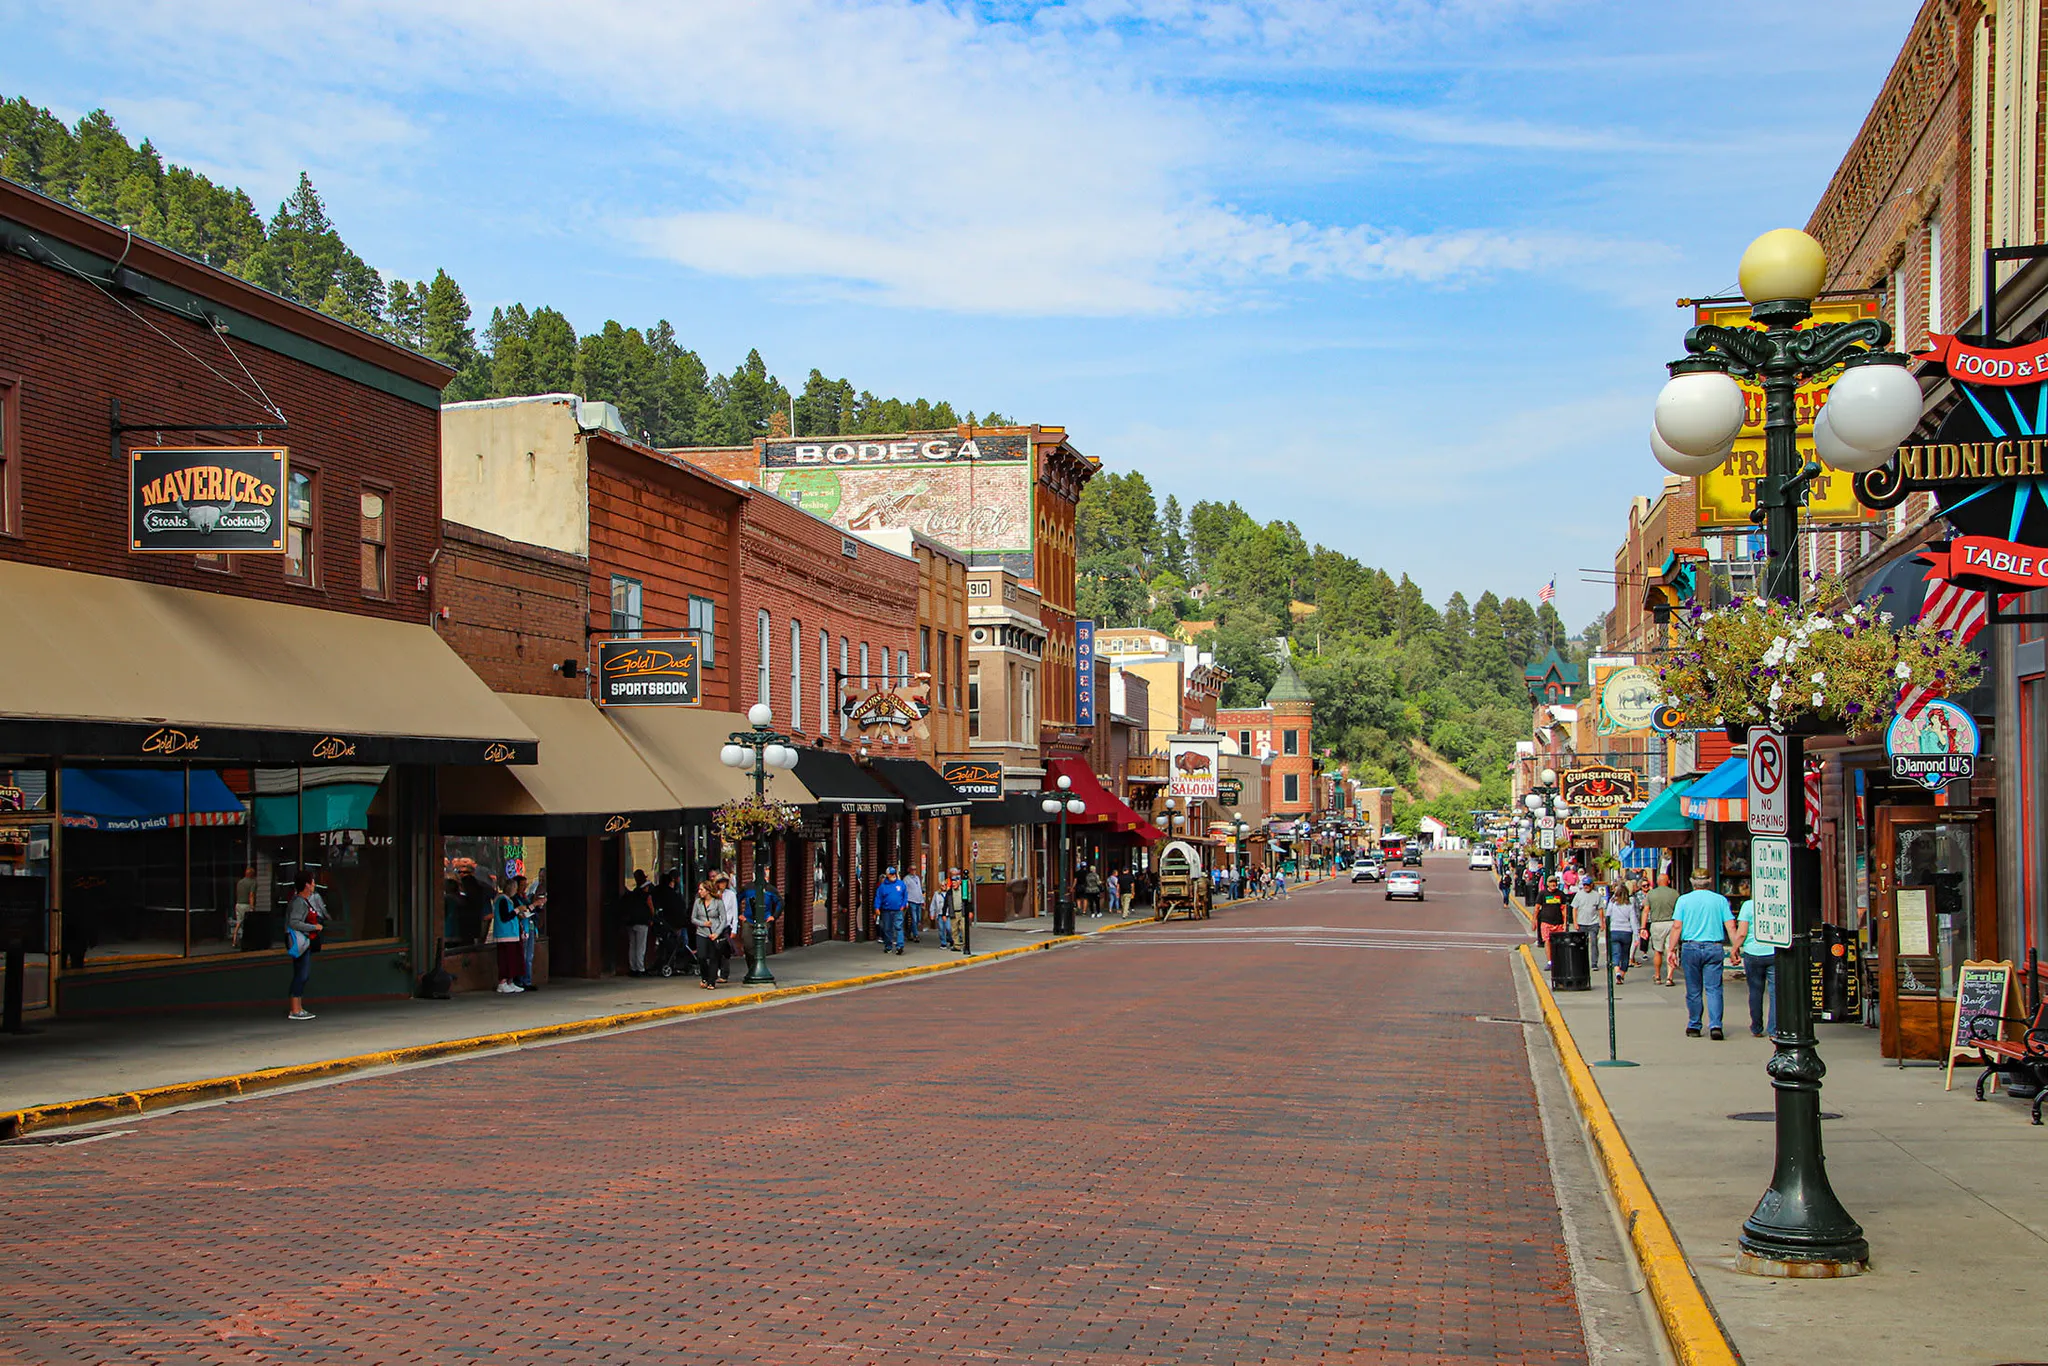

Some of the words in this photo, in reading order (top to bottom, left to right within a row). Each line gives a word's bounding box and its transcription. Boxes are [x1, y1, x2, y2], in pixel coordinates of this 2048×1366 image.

[1955, 352, 2014, 378] FOOD
[2017, 361, 2034, 376] &
[795, 439, 982, 464] BODEGA
[1896, 439, 2048, 481] MIDNIGH
[141, 465, 277, 507] MAVERICKS
[151, 515, 188, 527] Steaks
[219, 515, 265, 527] Cocktails
[1963, 545, 2033, 577] TABLE
[604, 649, 650, 672] Gold
[638, 649, 694, 673] Dust
[1078, 628, 1090, 719] BODEGA
[611, 681, 688, 696] SPORTSBOOK
[854, 693, 882, 719] JACOBS
[1633, 713, 1651, 722] STON
[142, 728, 173, 753] Gold
[166, 729, 200, 754] Dust
[312, 736, 335, 759] Gold
[328, 737, 356, 759] Dust
[944, 765, 974, 781] Gold
[966, 766, 1000, 781] Dust
[1896, 756, 1946, 775] Diamond
[1566, 771, 1632, 783] GUNSLINGER
[952, 785, 997, 794] -STORE
[1171, 783, 1215, 796] SALOON
[1574, 794, 1625, 805] SALOON
[1761, 799, 1772, 810] NO
[841, 803, 855, 813] SCOTT
[857, 803, 871, 813] JACOBS
[873, 803, 887, 813] STUDIO
[1751, 813, 1784, 827] PARKING
[1759, 848, 1767, 861] 20
[1771, 848, 1782, 862] MIN
[1756, 865, 1787, 881] UNLOADING
[1763, 884, 1779, 899] ZONE
[1757, 902, 1765, 915] 24
[1768, 903, 1787, 918] HOURS
[1759, 920, 1770, 935] PER
[1773, 921, 1785, 936] DAY
[1962, 994, 1993, 1009] Daily
